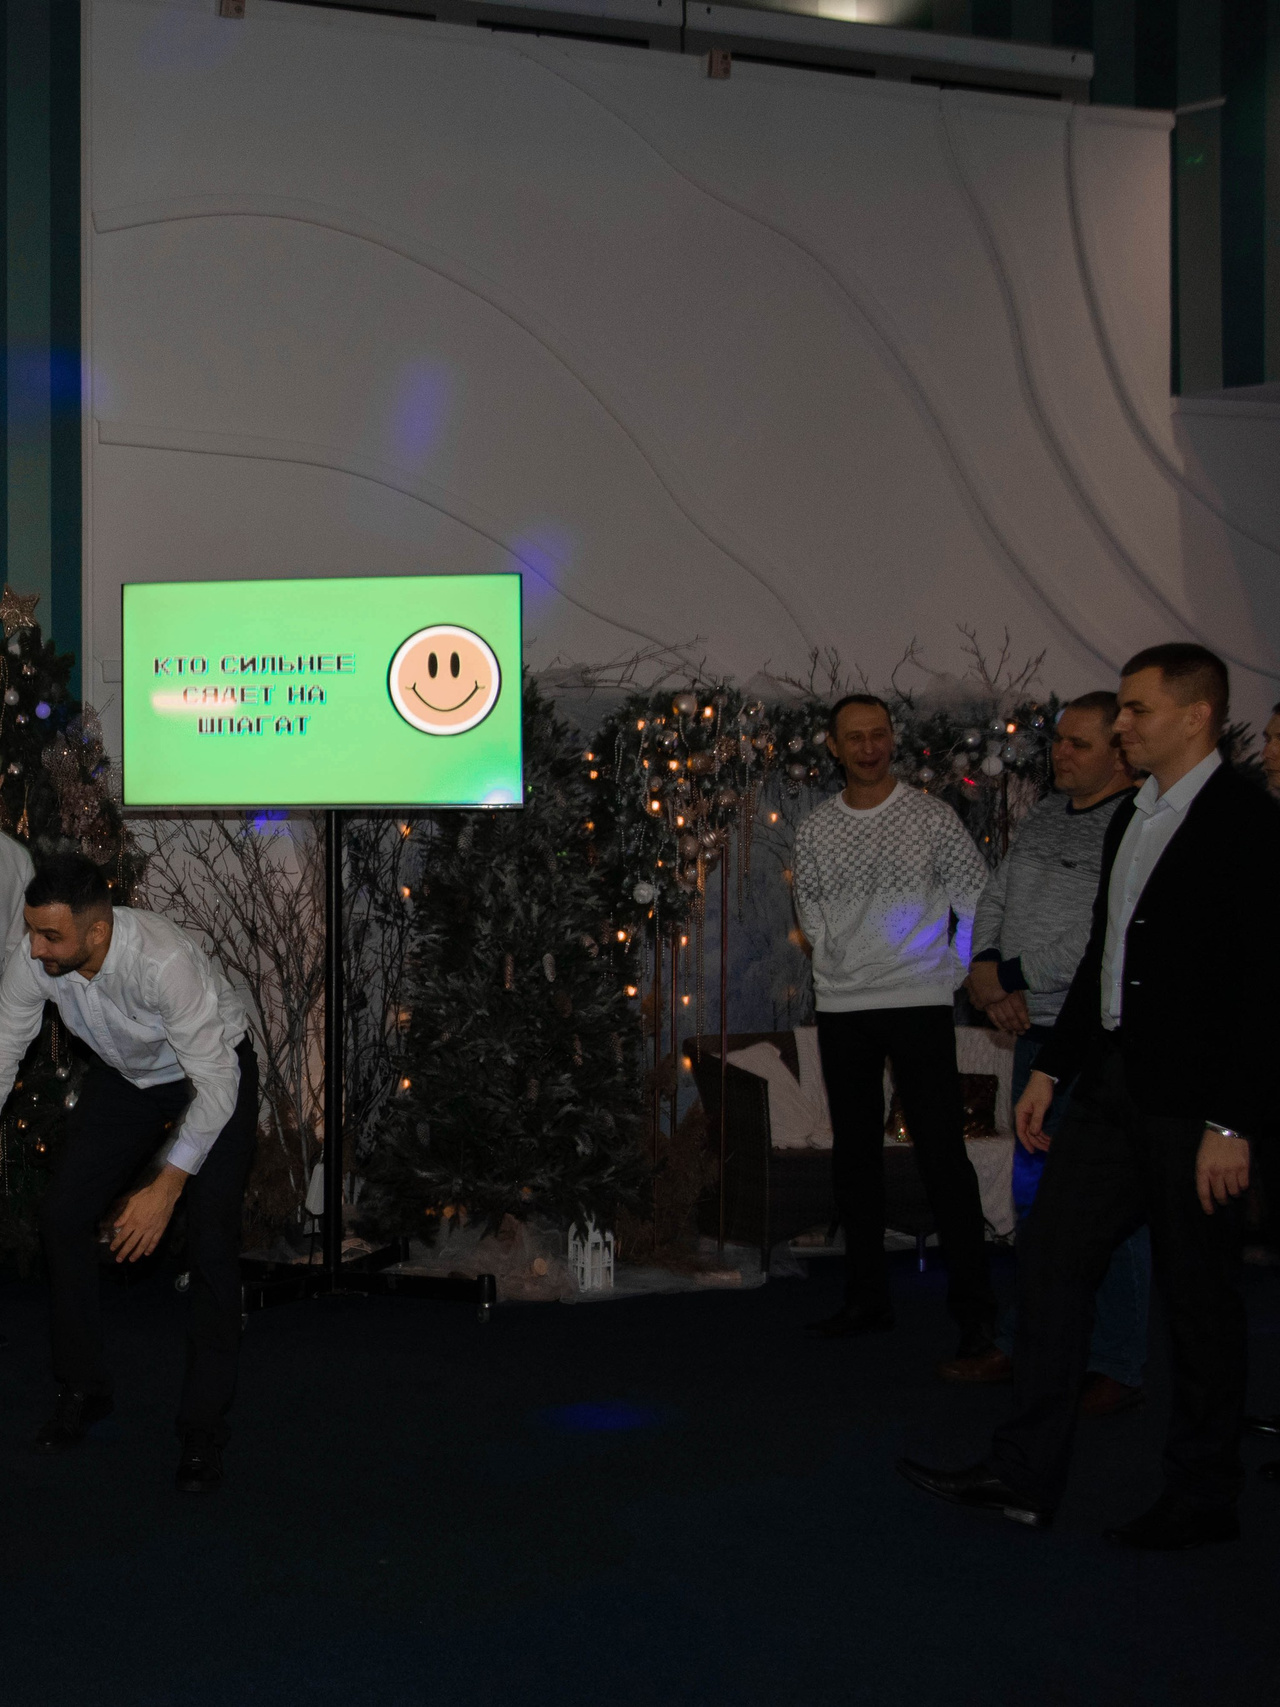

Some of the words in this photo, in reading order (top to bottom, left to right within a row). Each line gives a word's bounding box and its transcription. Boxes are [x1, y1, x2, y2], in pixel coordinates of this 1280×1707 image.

[154, 655, 209, 676] КТО
[220, 652, 355, 674] СИЛЬНЕЕ
[182, 685, 274, 705] СЯДЕТ
[287, 684, 328, 704] НА
[197, 715, 311, 736] ШПАГАТ
